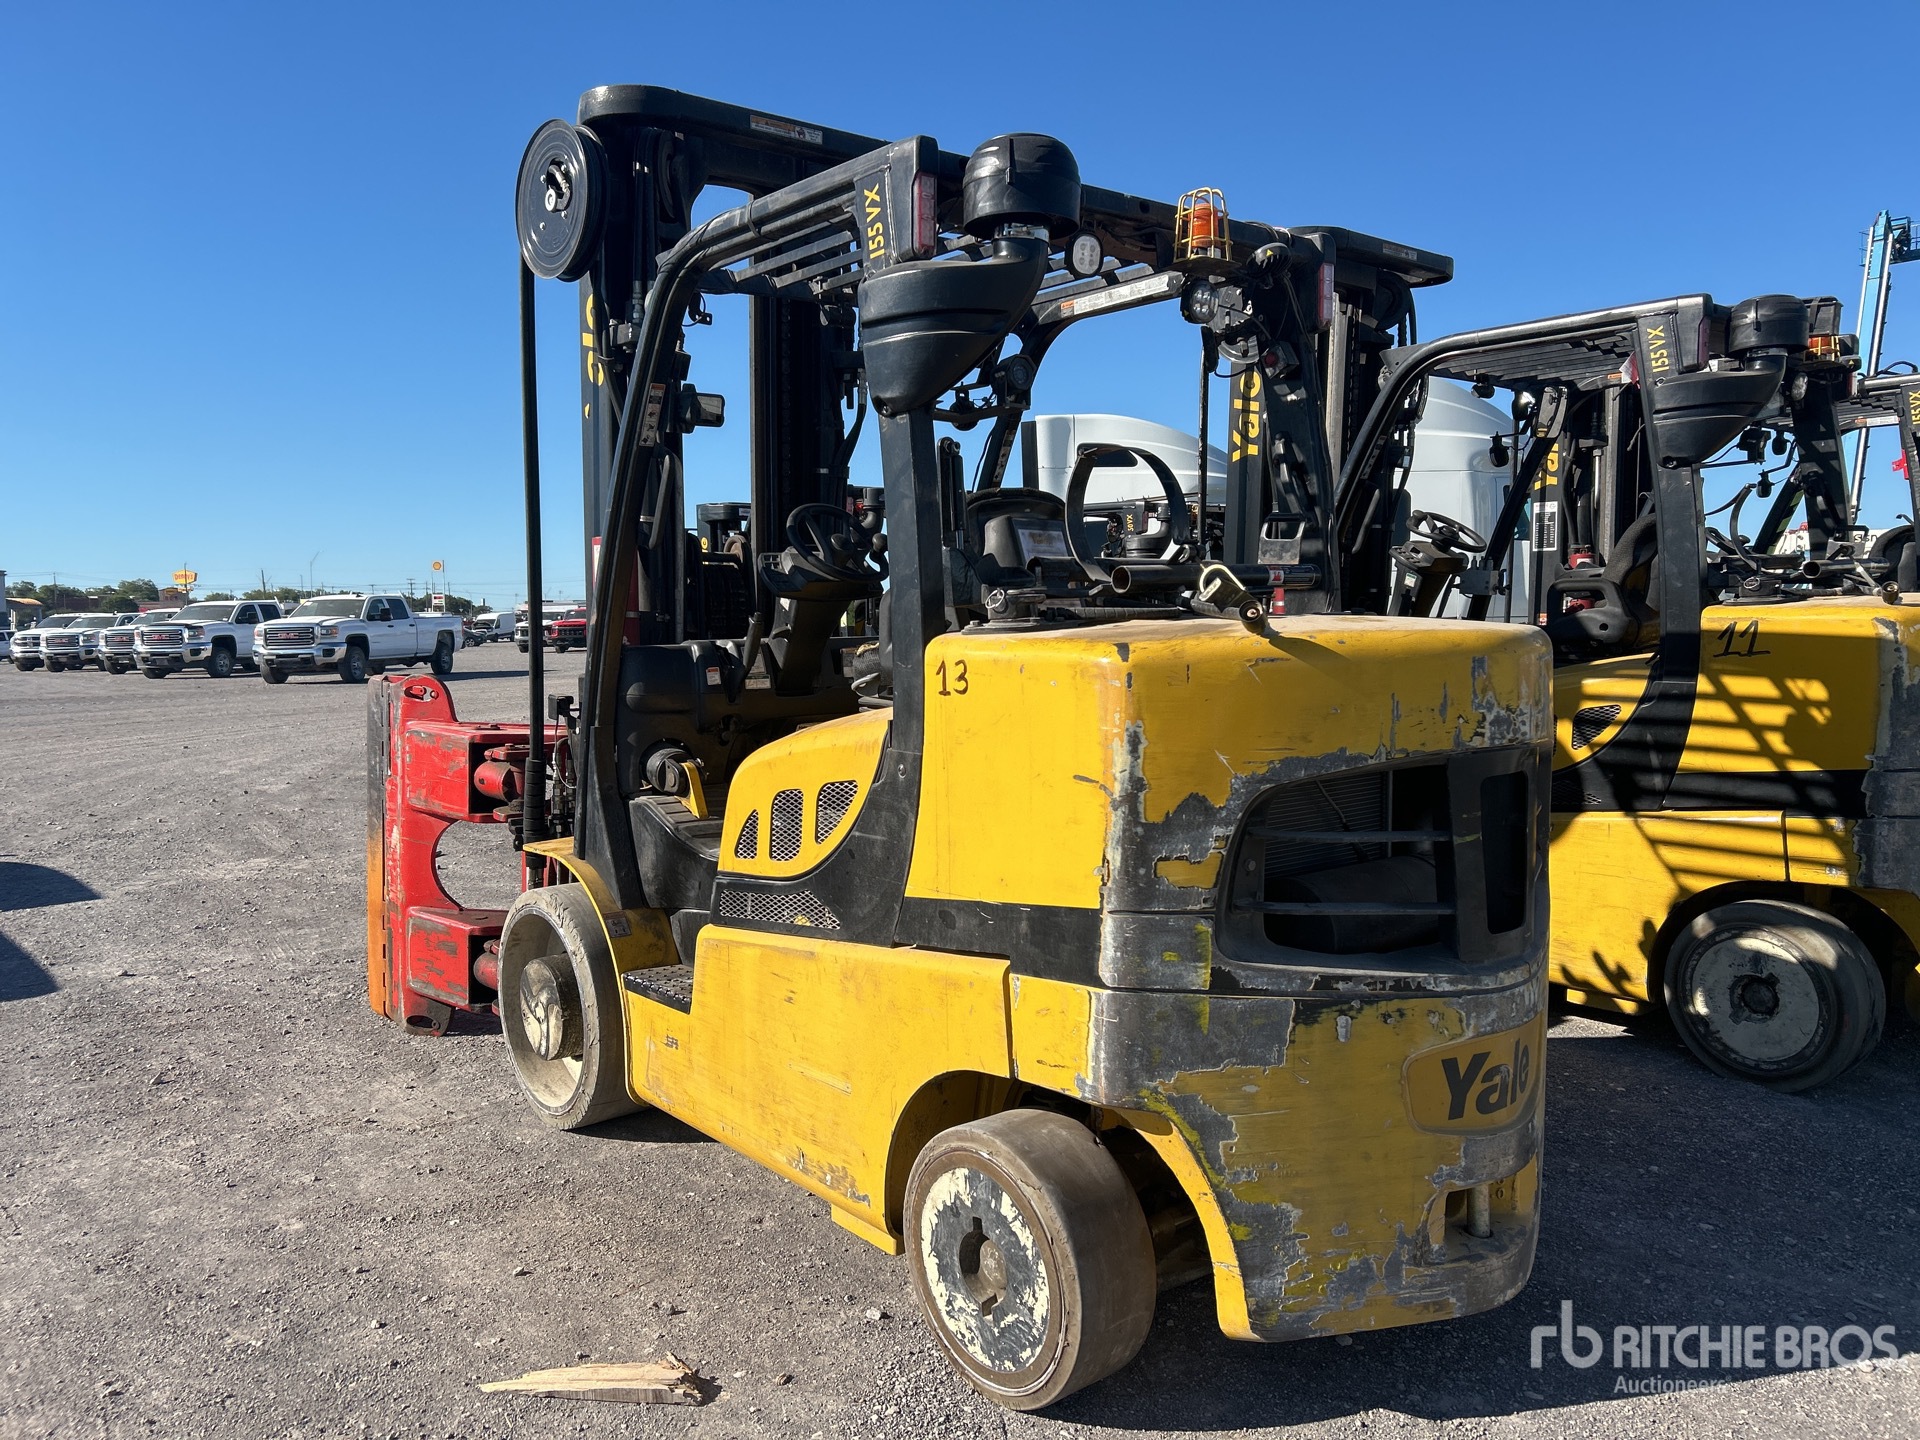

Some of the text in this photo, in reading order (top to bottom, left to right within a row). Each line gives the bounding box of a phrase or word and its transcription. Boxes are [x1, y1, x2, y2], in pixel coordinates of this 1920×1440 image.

[864, 183, 885, 259] 155VX
[1647, 325, 1670, 372] 155VX
[1232, 371, 1261, 462] Yale
[1713, 620, 1771, 657] 11
[936, 659, 968, 696] 13
[1441, 1038, 1530, 1121] Yale
